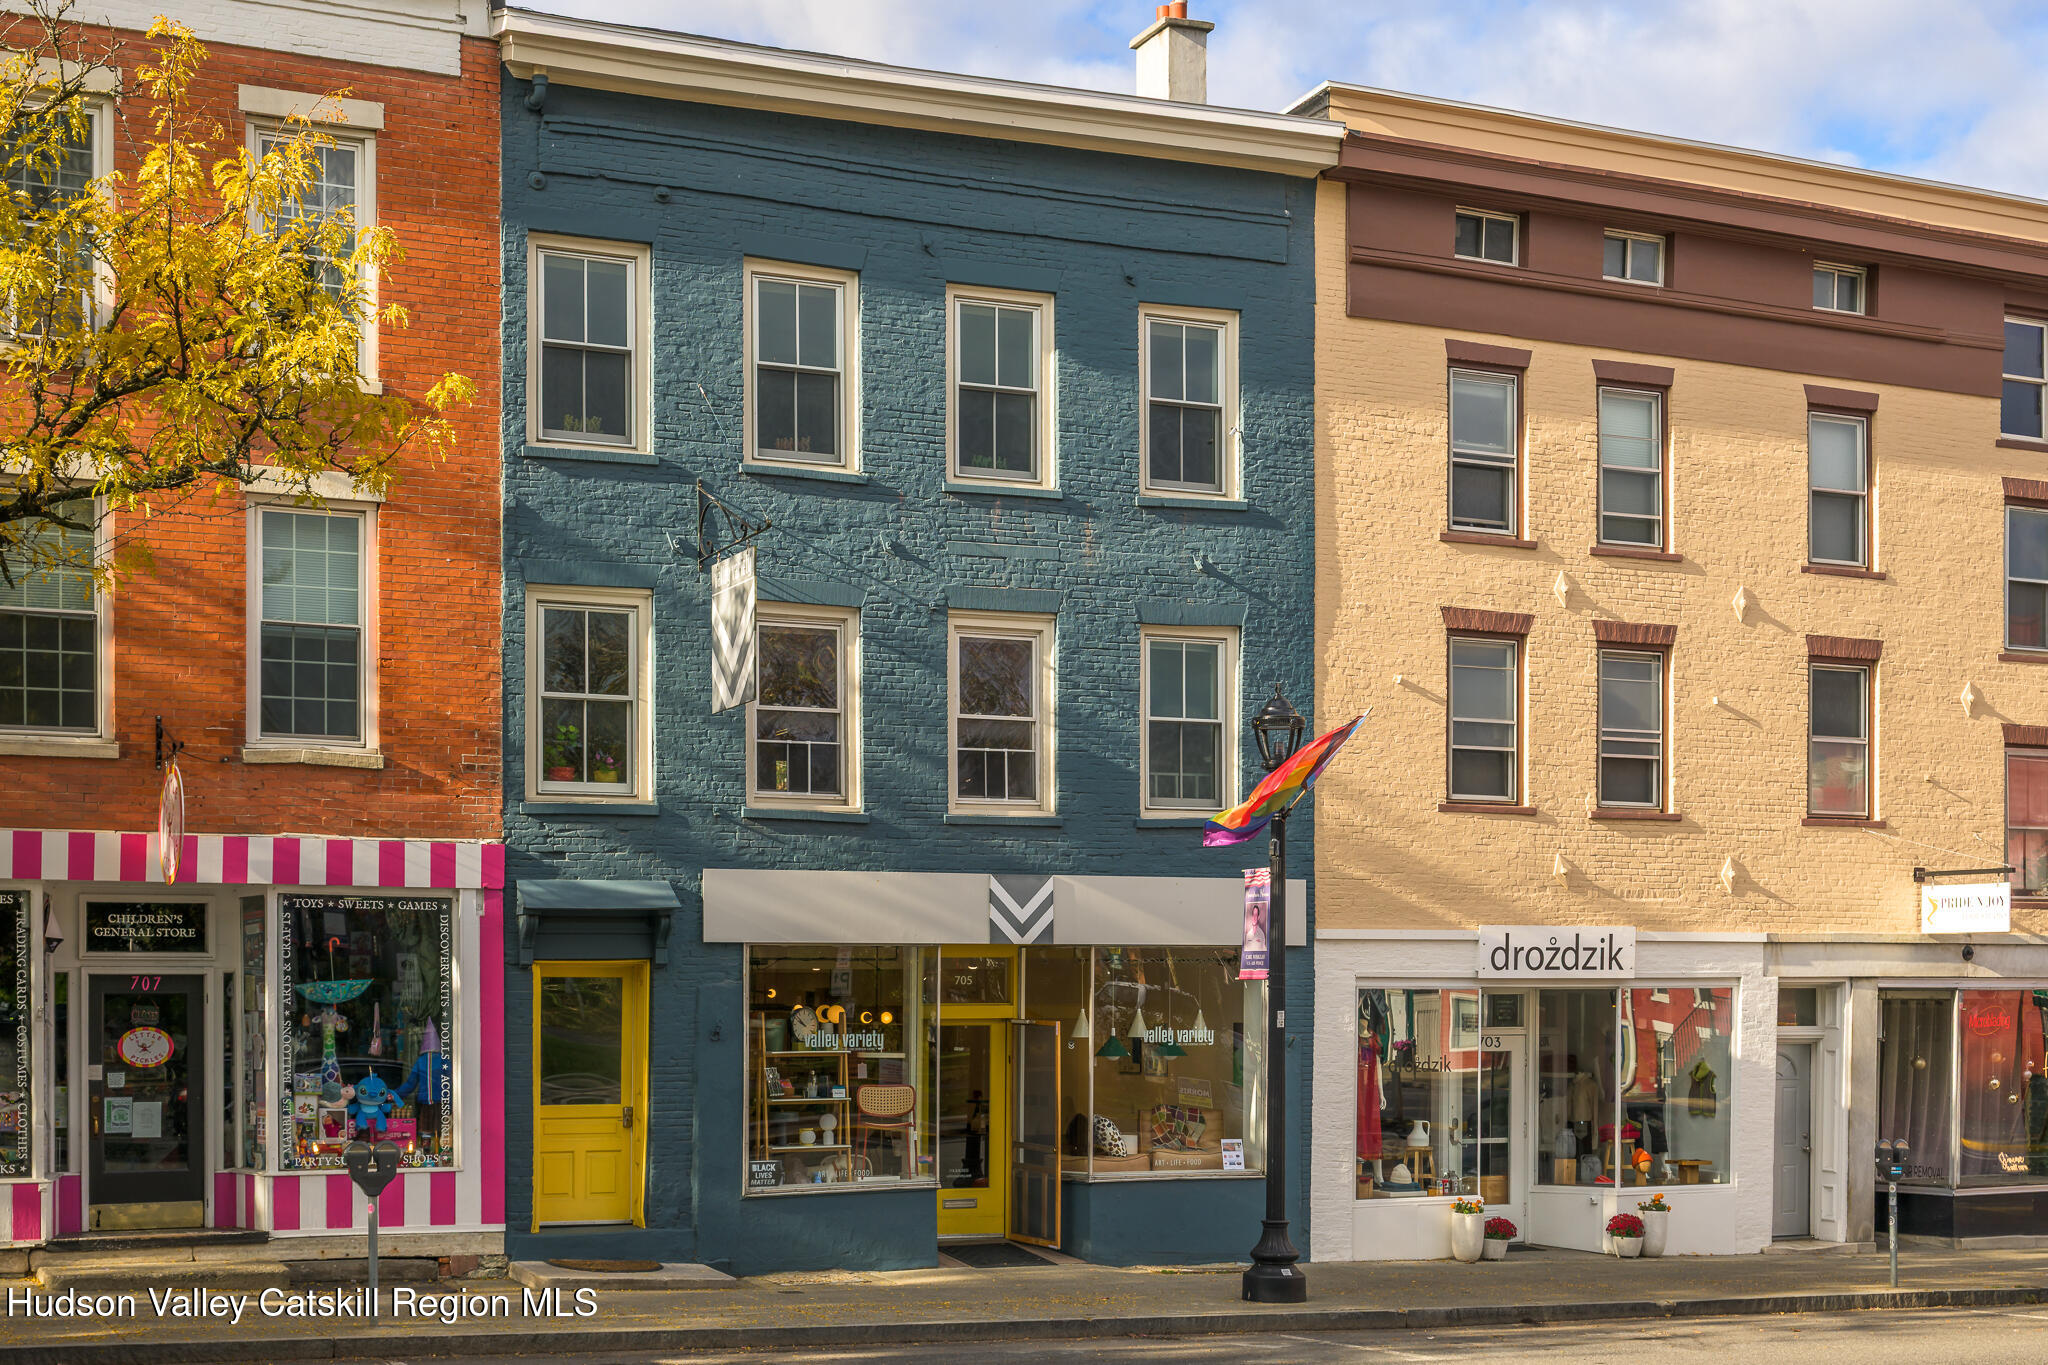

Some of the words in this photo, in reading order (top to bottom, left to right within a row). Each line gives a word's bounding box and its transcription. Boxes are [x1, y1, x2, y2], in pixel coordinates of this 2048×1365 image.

[293, 898, 324, 909] TOYS
[338, 899, 384, 910] SWEETS
[397, 901, 438, 911] GAMES
[107, 913, 183, 925] CHILDREN'S
[16, 909, 27, 967] TRADING
[94, 927, 154, 937] GENERAL
[156, 927, 196, 938] STORE
[282, 912, 291, 959] CRAFTS
[440, 914, 449, 979] DISCOVERY
[285, 962, 292, 972] &
[130, 975, 161, 991] 707
[954, 975, 973, 985] 705
[16, 970, 27, 1010] CARDS
[282, 975, 291, 1005] ARTS
[440, 981, 449, 1007] KITS
[128, 1031, 162, 1041] LITTLE
[440, 1022, 450, 1060] DOLLS
[804, 1029, 839, 1051] valley
[842, 1029, 884, 1050] variety
[1143, 1026, 1174, 1046] valley
[1177, 1026, 1215, 1046] variety
[16, 1025, 27, 1088] COSTUMES
[130, 1053, 164, 1064] PICKLES
[282, 1020, 292, 1083] BALLOONS
[441, 1074, 450, 1151] ACCESSORIES
[17, 1103, 27, 1159] CLOTHES
[282, 1098, 291, 1154] MARBLES
[295, 1156, 333, 1167] PARTY
[402, 1154, 439, 1164] SHOES
[751, 1163, 776, 1172] BLACK
[1186, 1158, 1202, 1166] FOOD
[754, 1171, 773, 1179] LIVES
[1914, 1165, 1945, 1180] REMOVAL
[750, 1178, 776, 1186] MATTER
